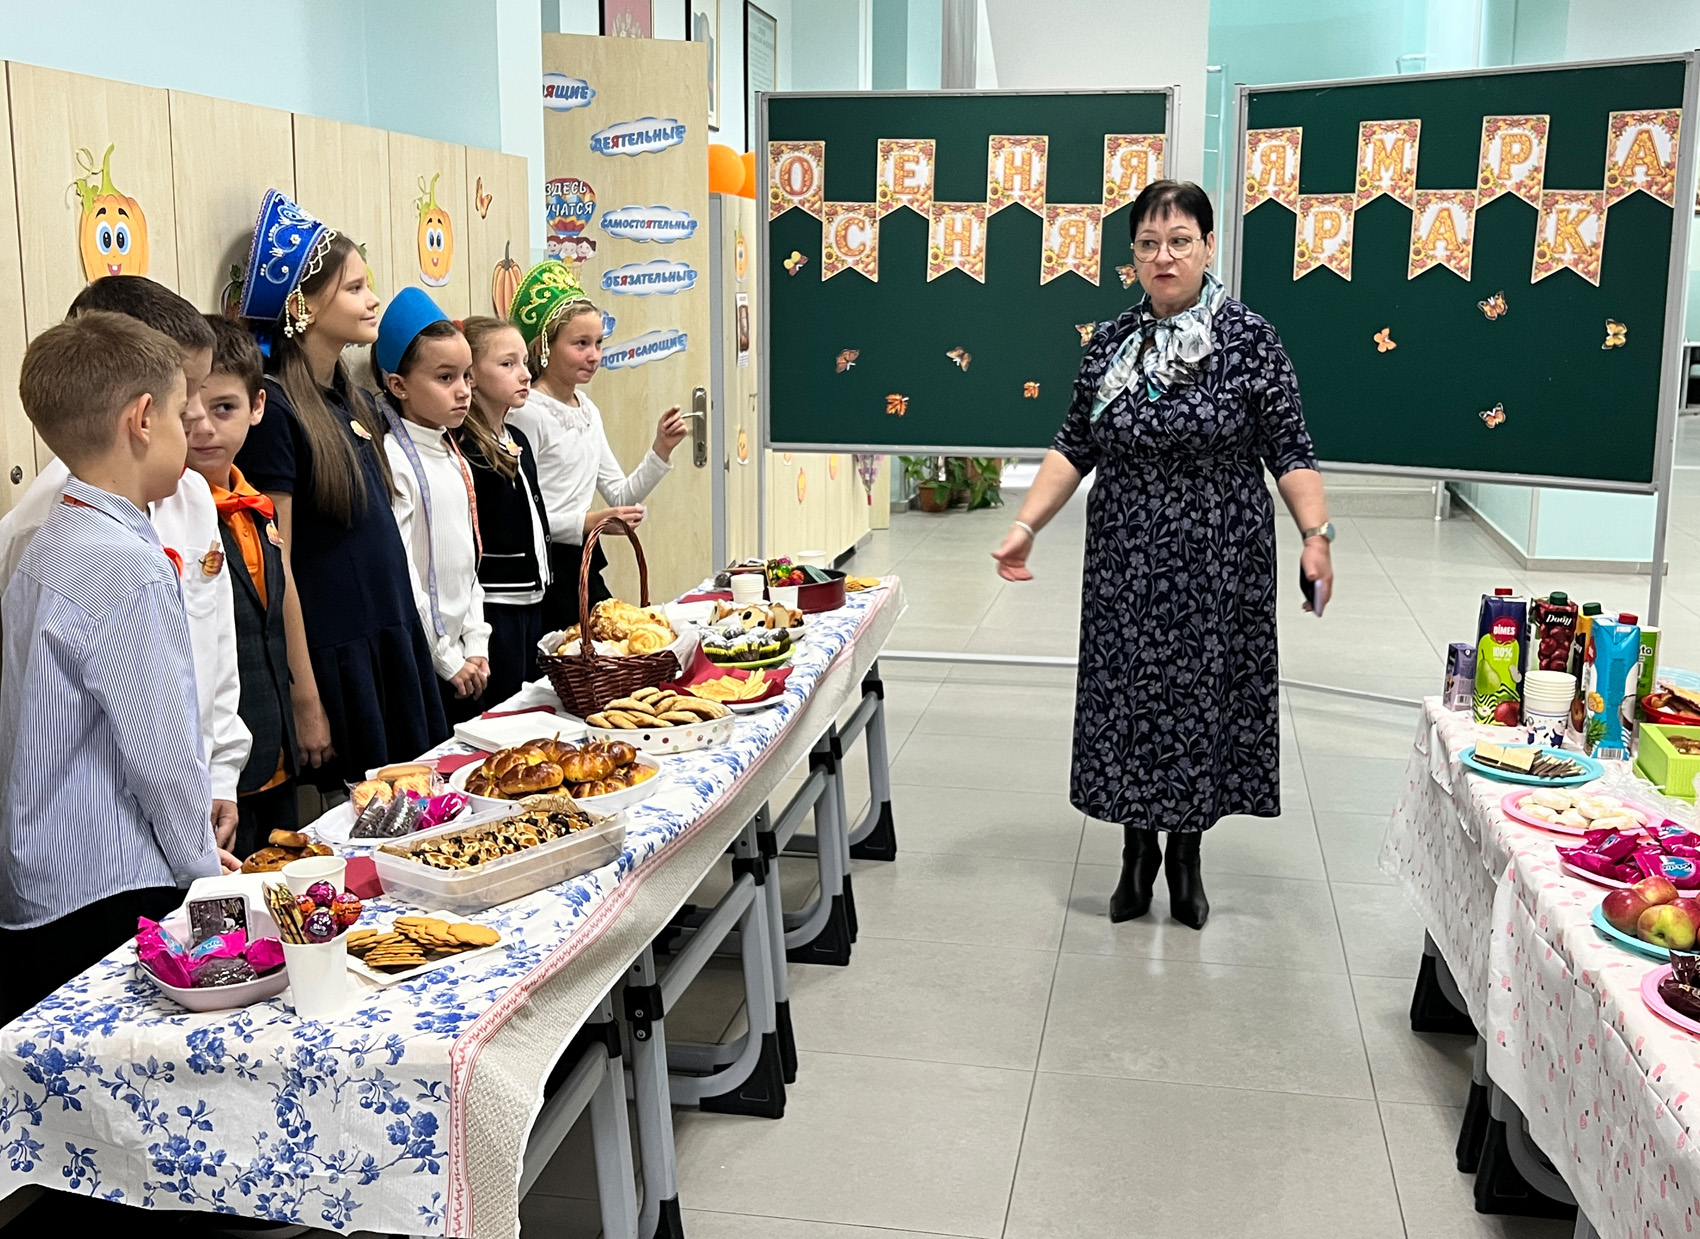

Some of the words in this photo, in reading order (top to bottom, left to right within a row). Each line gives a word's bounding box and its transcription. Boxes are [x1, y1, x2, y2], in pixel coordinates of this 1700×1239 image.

[542, 84, 589, 100] ЯЩИЕ
[591, 125, 686, 152] ДЕЯТЕЛЬНЫЕ
[545, 181, 587, 197] ЗДЕСЬ
[600, 333, 688, 367] ПОТРЯСАЮЩИЕ
